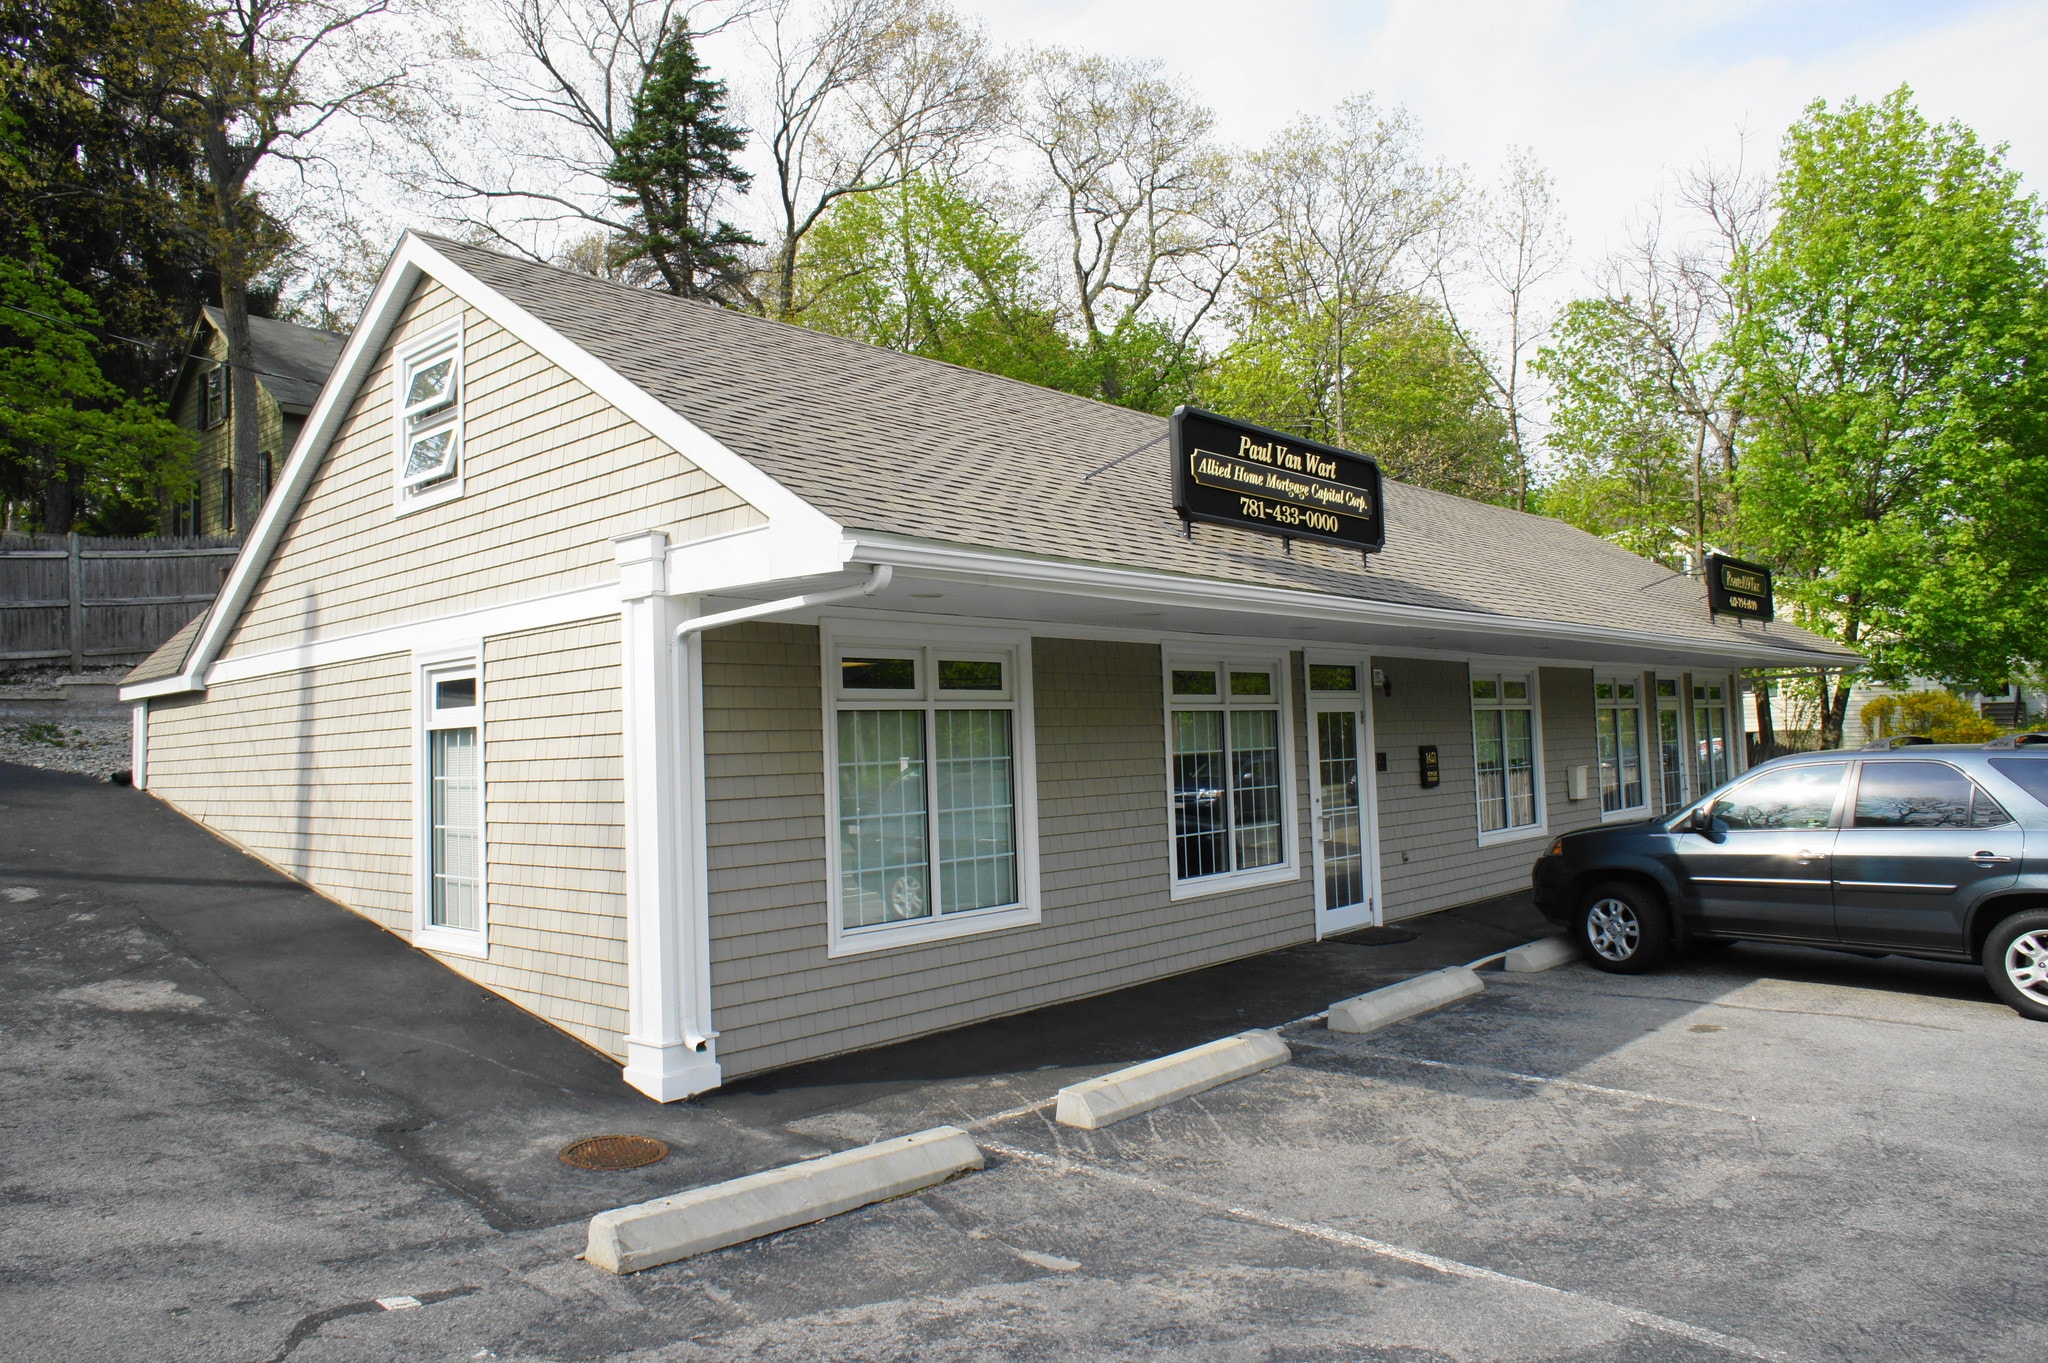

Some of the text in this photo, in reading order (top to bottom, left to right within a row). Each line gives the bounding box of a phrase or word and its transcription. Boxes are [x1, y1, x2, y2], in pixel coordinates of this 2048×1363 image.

[1238, 436, 1336, 479] Paul Van Wart
[1198, 458, 1368, 512] Allied Home Mortgage Capital Corp.
[1240, 497, 1338, 532] 781-433-0000
